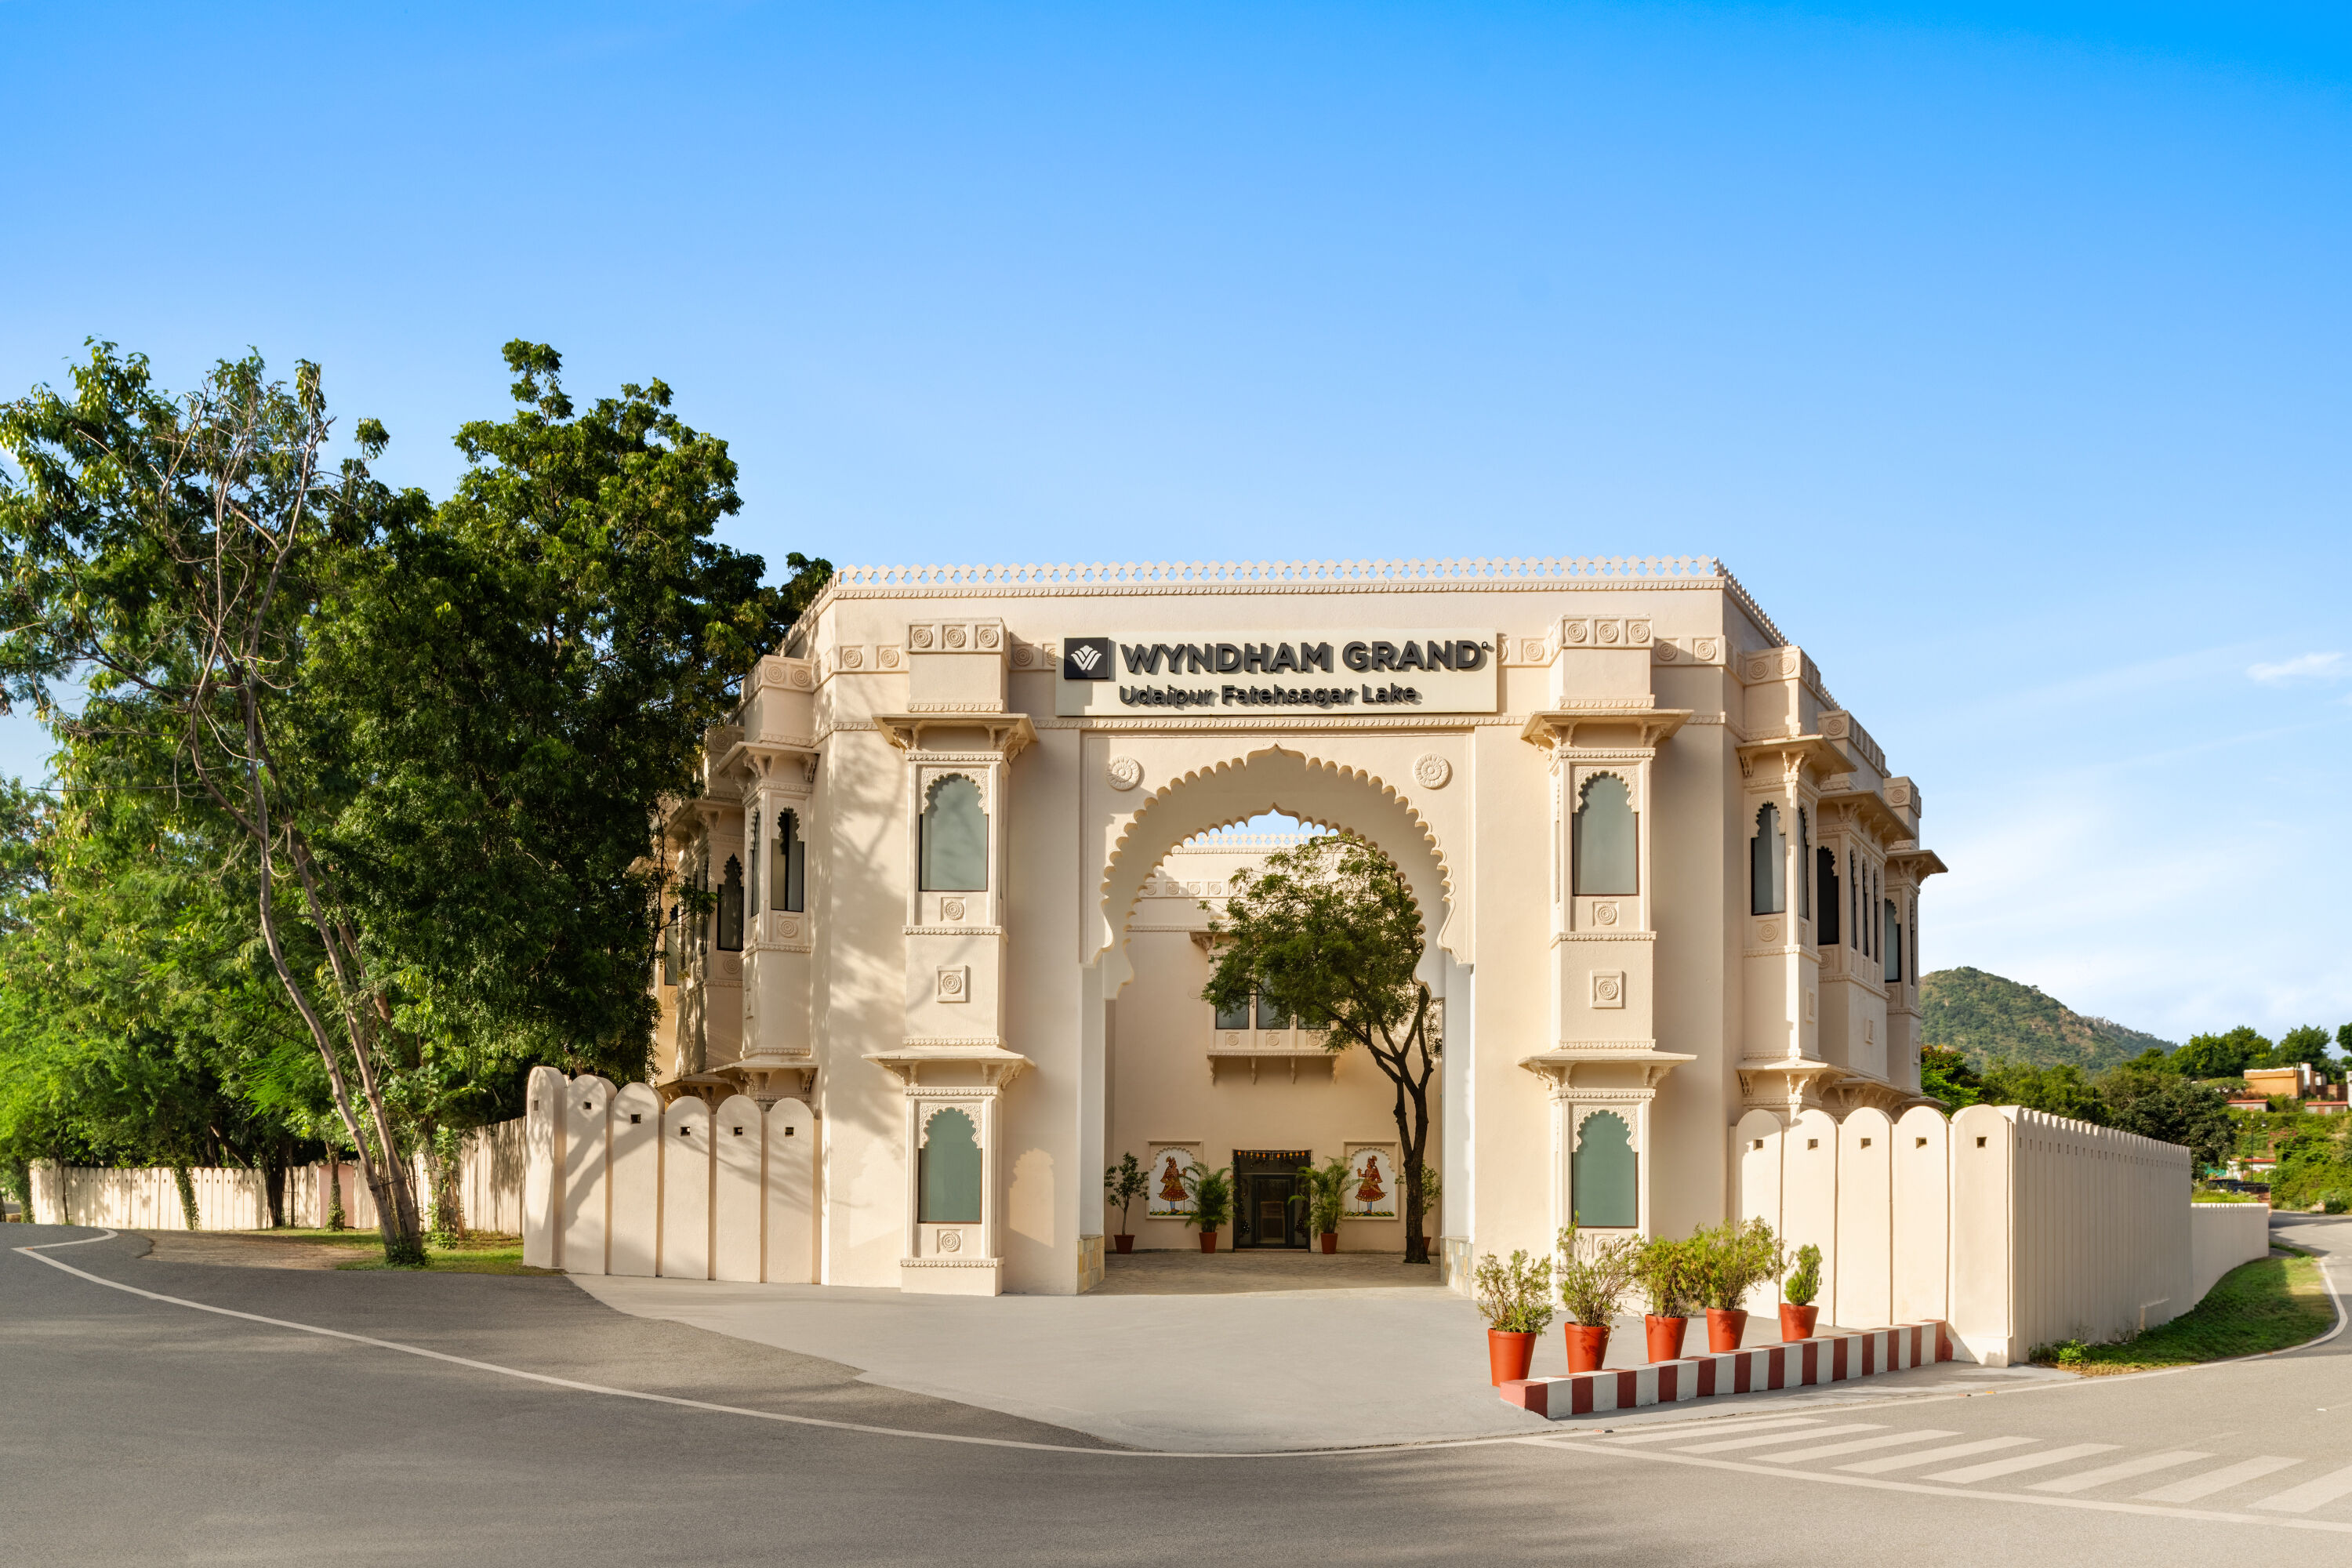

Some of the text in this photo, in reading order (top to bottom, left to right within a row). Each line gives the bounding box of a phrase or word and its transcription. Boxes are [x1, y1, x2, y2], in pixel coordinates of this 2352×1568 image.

[1120, 641, 1329, 673] WYNDHAM
[1119, 682, 1417, 709] Udaipur Fatehsagar Lake
